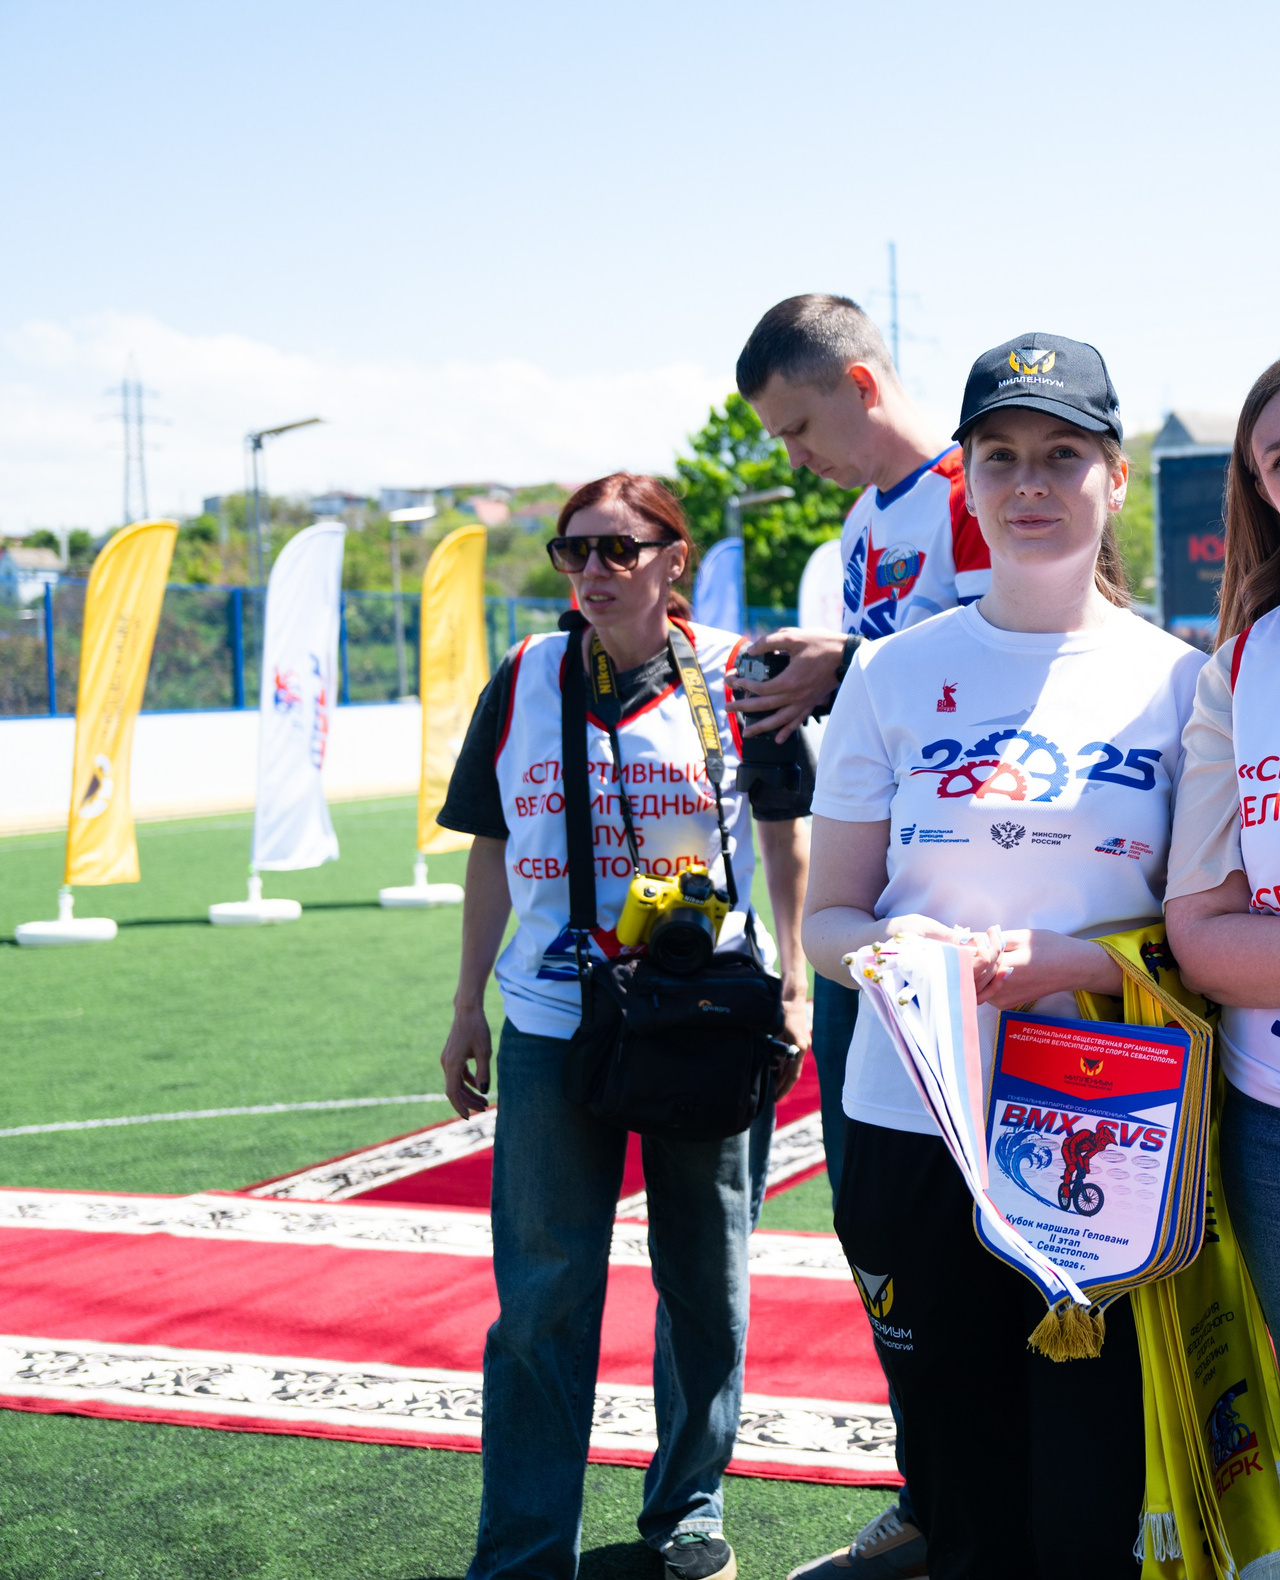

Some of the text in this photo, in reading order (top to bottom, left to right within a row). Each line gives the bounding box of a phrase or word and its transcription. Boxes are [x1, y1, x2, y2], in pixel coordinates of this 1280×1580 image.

[998, 376, 1064, 388] МИЛЛЕНИУМ
[599, 653, 613, 695] Nikon
[682, 667, 719, 749] Nikon D750
[522, 758, 709, 785] «СПРТИВНЫЙ
[515, 791, 719, 819] ВЕЛОИПЕДНЫЙ
[593, 825, 645, 848] ЛУБ
[1031, 832, 1072, 840] МИНСПОРТ
[683, 894, 705, 905] Nikon
[1008, 1033, 1178, 1065] «ФЕДЕРАЦИЯ ВЕЛОСИПЕДНОГО СПОРТА СЕВАСТОПОЛЯ»
[1022, 1027, 1169, 1055] РЕГИОНАЛЬНАЯ ОБЩЕСТВЕННАЯ ОРГАНИЗАЦИЯ
[1064, 1074, 1113, 1087] МИЛЛЕНИУМ
[1048, 1100, 1075, 1110] ПАРТНЕР
[1000, 1103, 1168, 1152] BMX SVS
[1005, 1213, 1130, 1246] Кубок маршала Геловани
[1036, 1240, 1100, 1261] Севастополь
[1057, 1237, 1081, 1248] этап
[1080, 1263, 1086, 1271] г.
